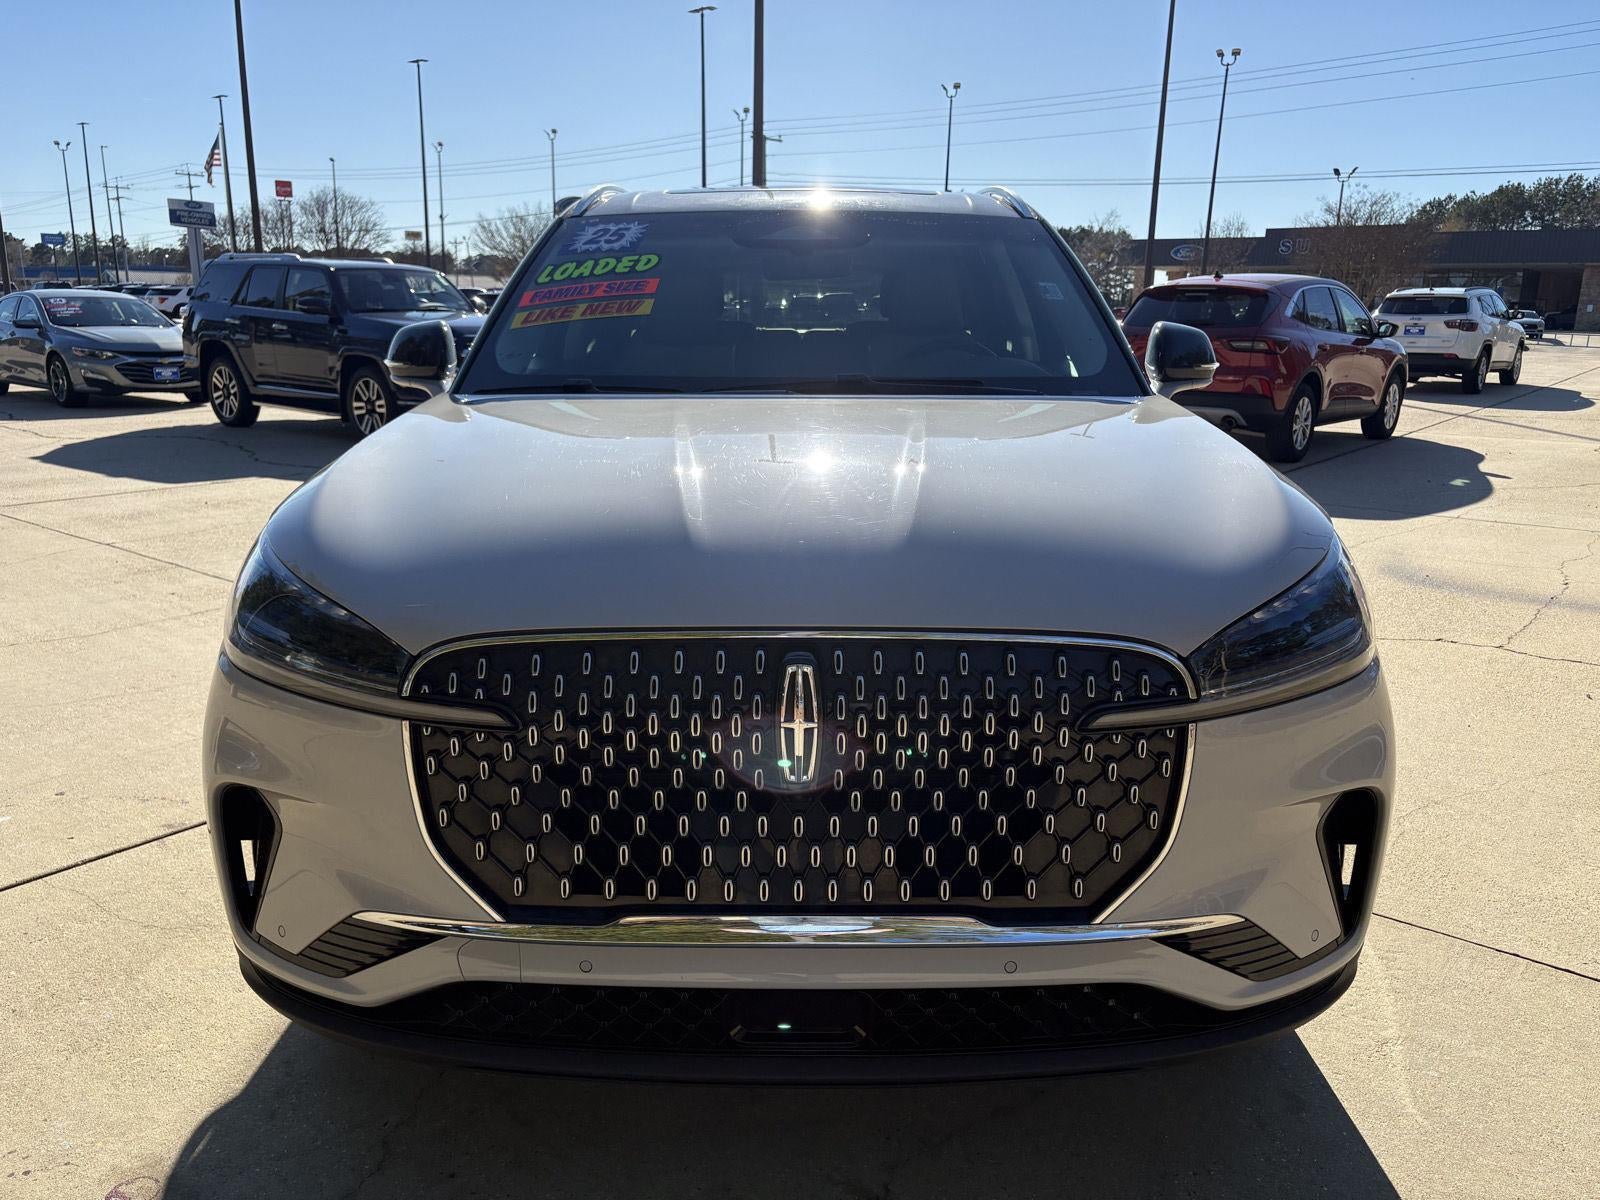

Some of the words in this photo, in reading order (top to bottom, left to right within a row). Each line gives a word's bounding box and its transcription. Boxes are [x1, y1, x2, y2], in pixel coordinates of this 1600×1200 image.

[582, 226, 631, 246] 25
[537, 254, 659, 284] LOADED
[530, 283, 600, 303] FAMILY
[603, 279, 648, 293] SIZE
[520, 306, 579, 326] LIKE
[580, 300, 645, 317] NEW
